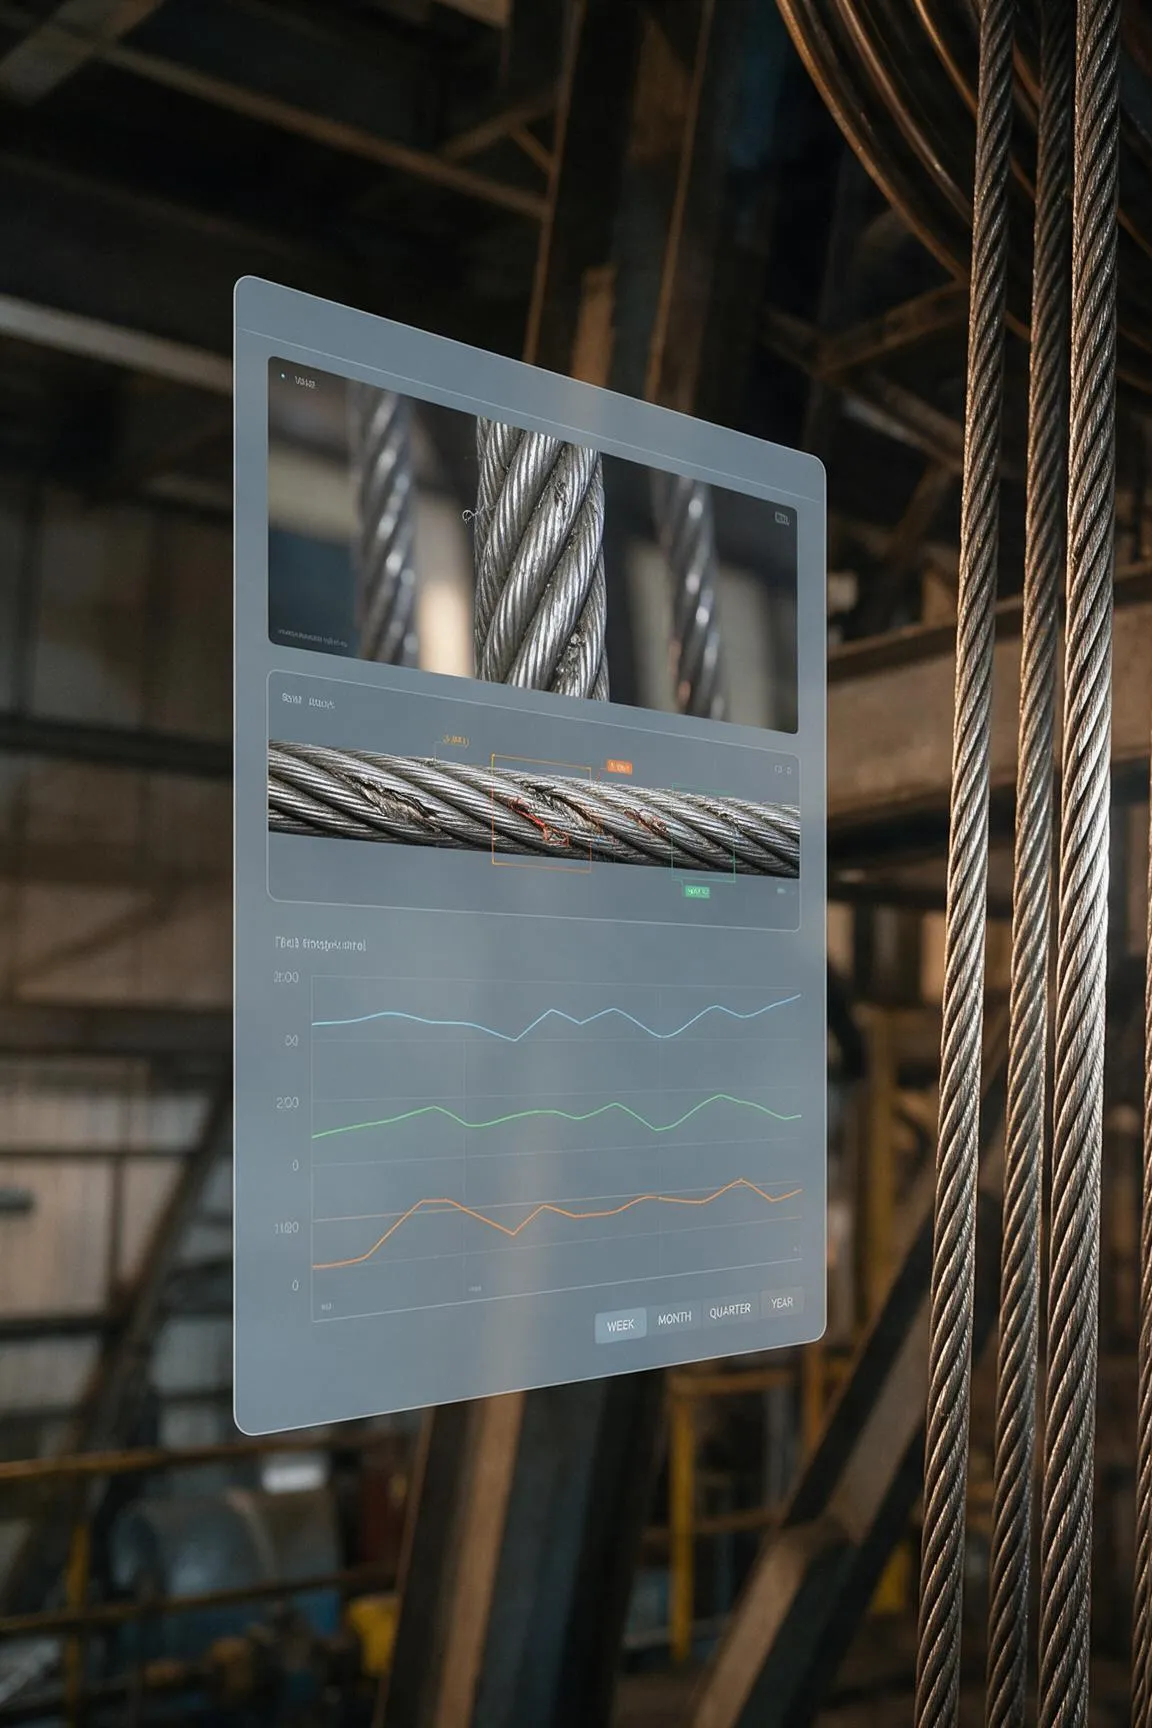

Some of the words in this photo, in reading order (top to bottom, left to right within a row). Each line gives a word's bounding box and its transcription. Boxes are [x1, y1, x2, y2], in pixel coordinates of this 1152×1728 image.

[606, 1318, 635, 1332] WEEK
[658, 1311, 692, 1326] MONTH
[709, 1302, 751, 1319] QUARTER
[771, 1296, 794, 1309] YEAR
